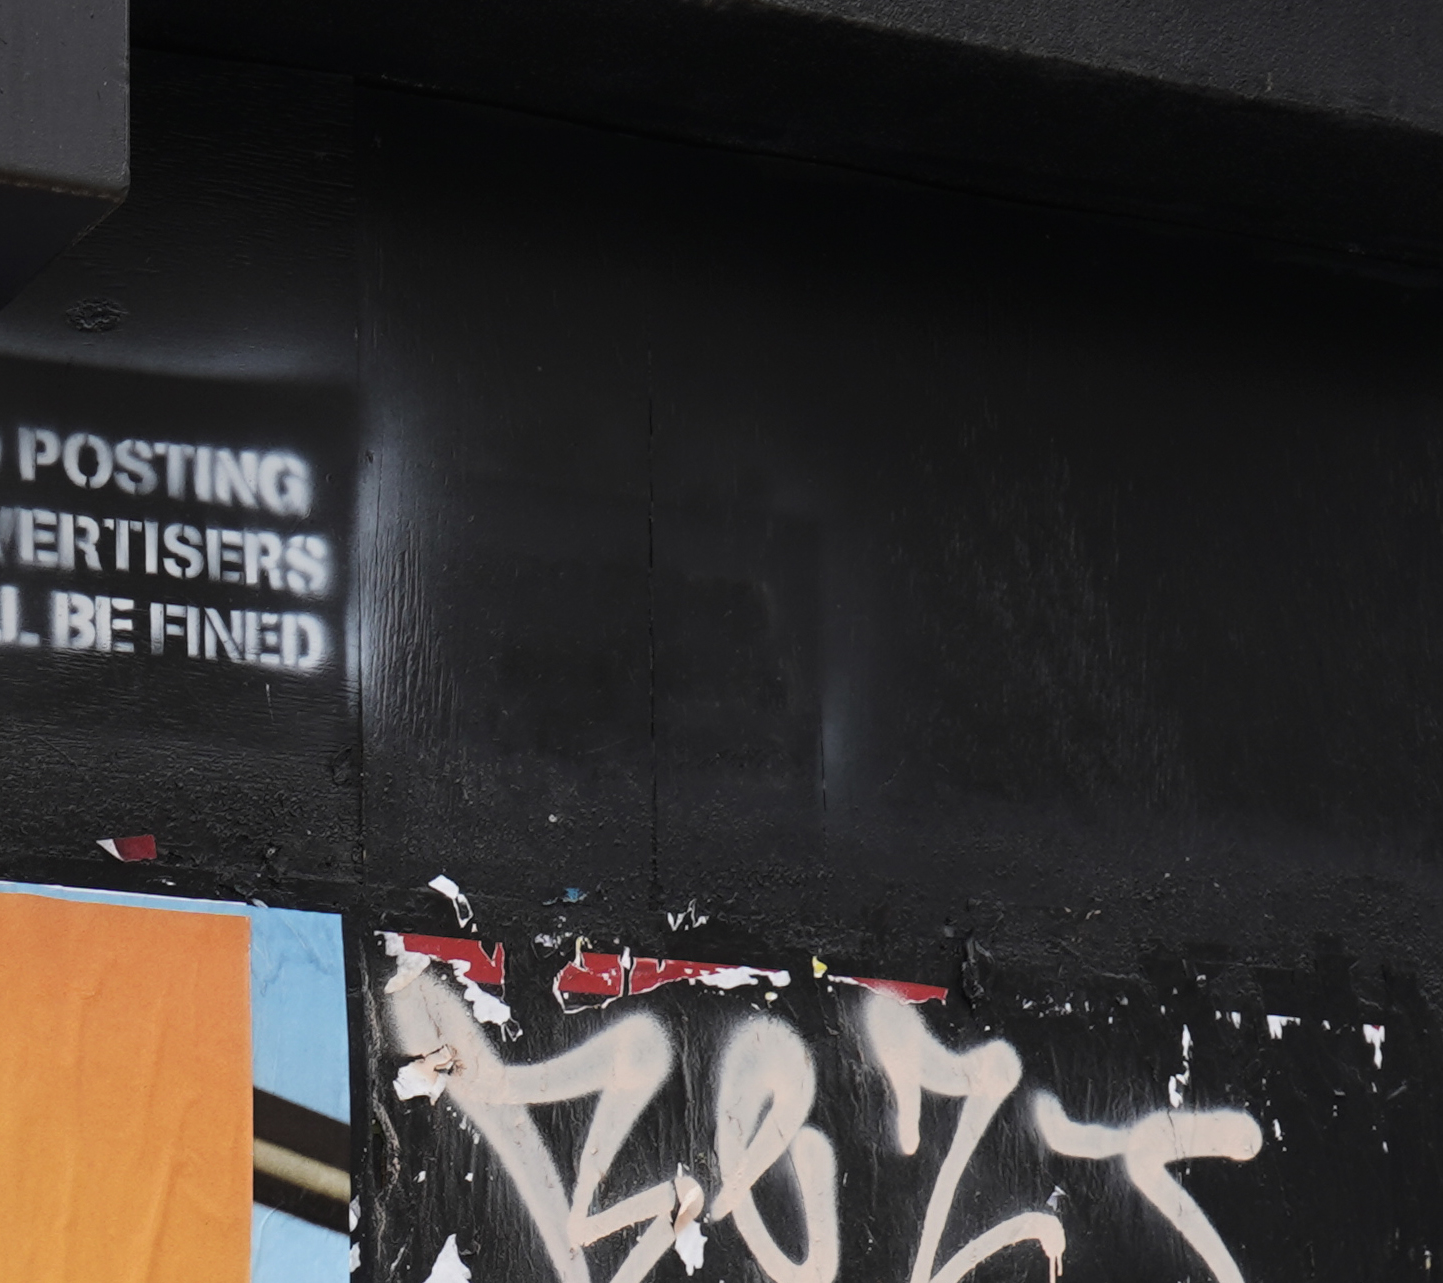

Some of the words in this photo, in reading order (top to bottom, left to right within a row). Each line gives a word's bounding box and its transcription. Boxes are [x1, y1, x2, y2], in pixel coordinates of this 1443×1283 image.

[18, 427, 312, 517] POSTING
[51, 590, 137, 653] BE
[149, 602, 326, 674] FINED
